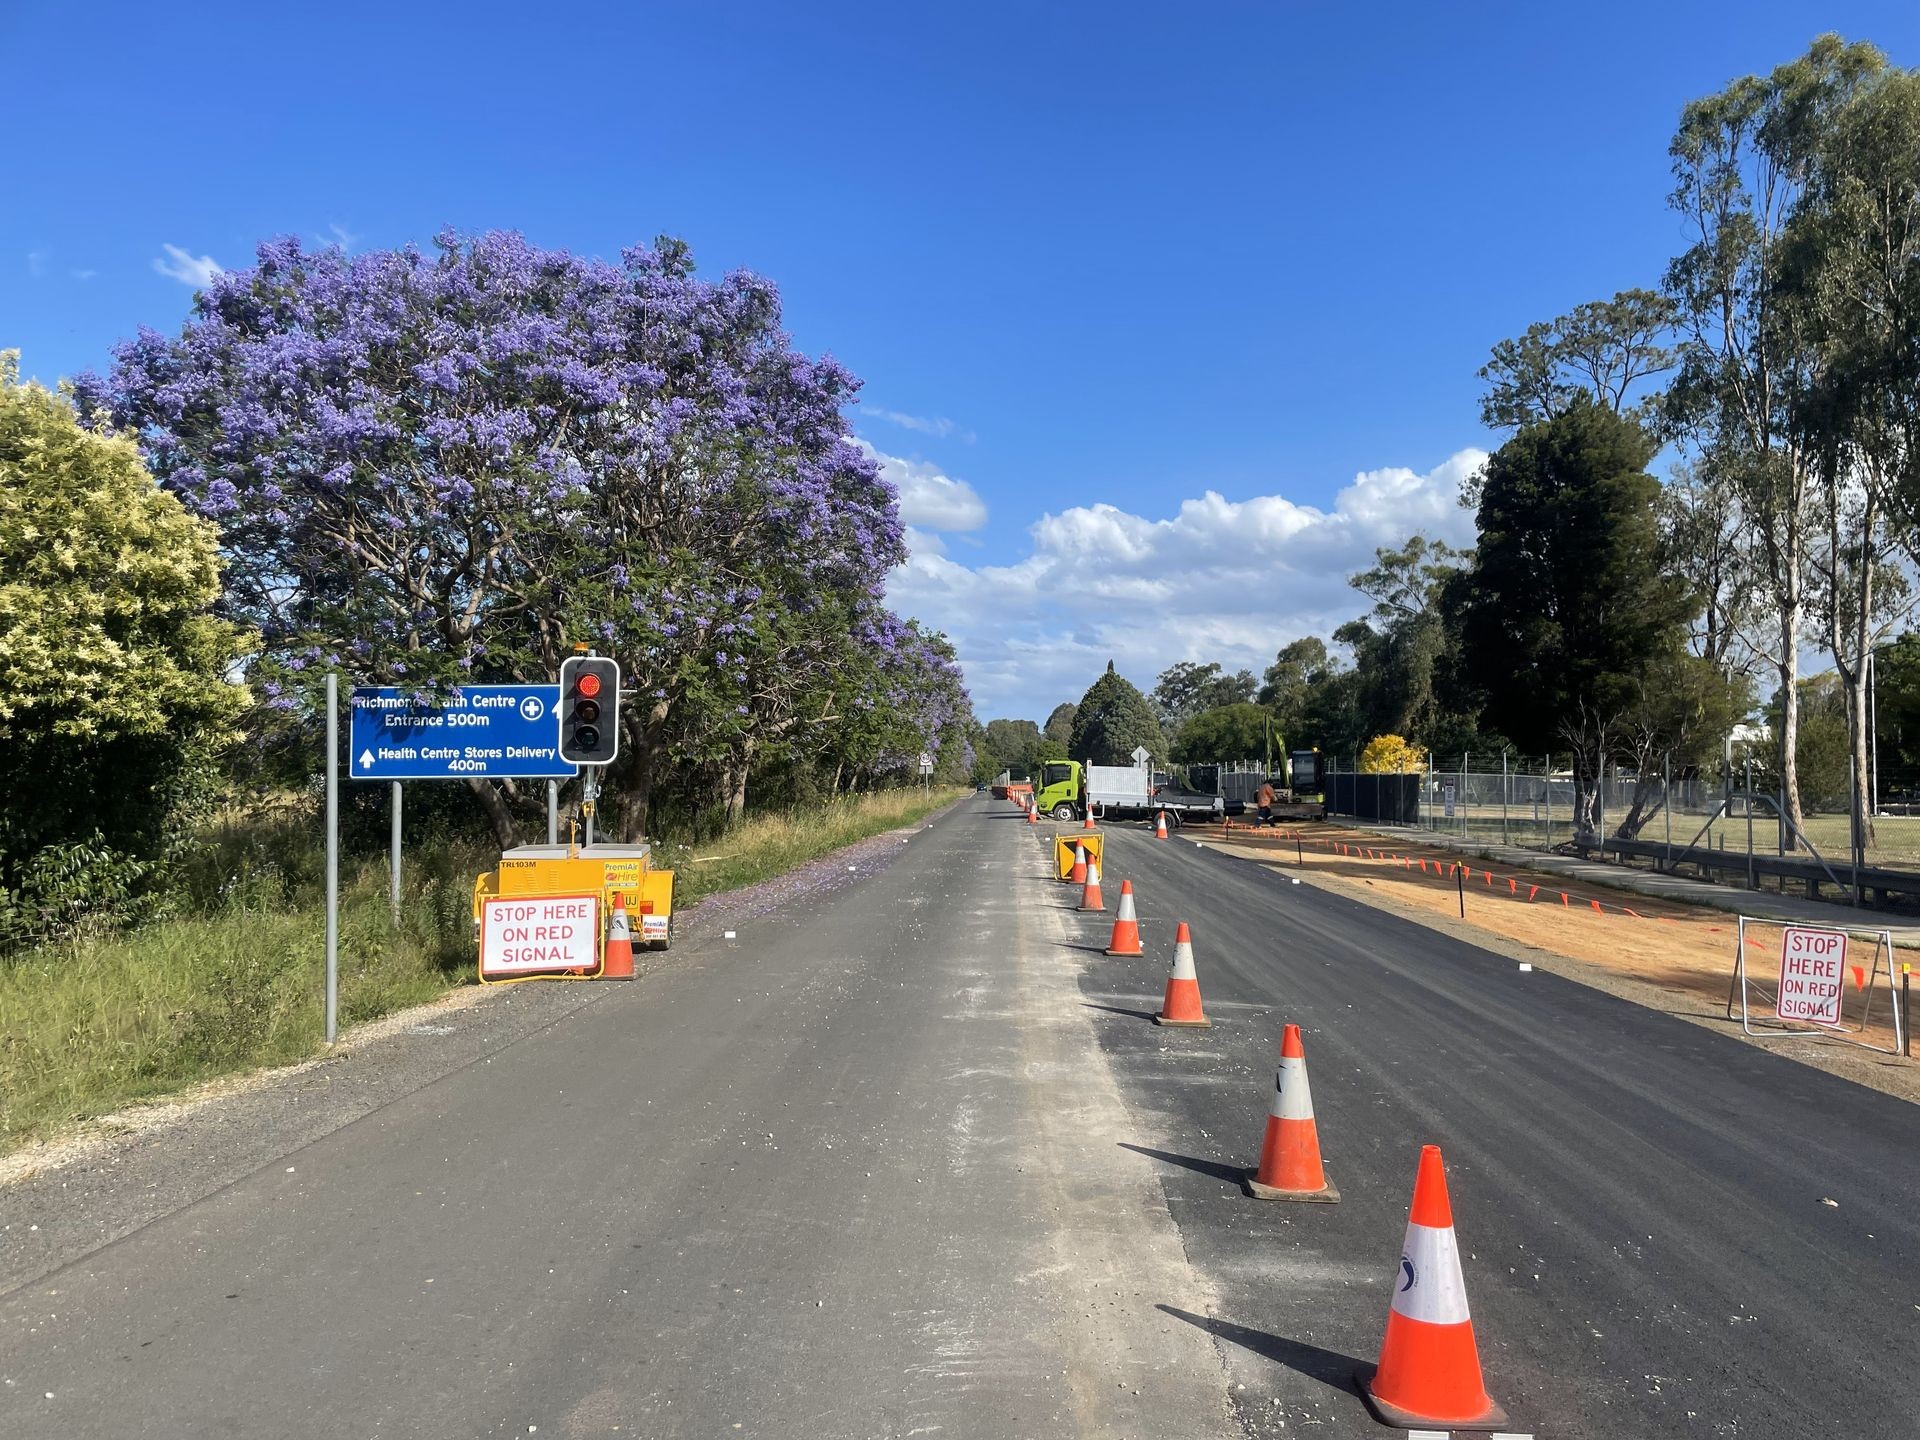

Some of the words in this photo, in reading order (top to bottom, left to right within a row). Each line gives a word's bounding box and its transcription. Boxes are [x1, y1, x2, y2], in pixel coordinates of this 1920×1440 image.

[472, 694, 516, 707] Centre
[385, 714, 443, 727] Entrance
[447, 713, 490, 727] 500m
[378, 748, 417, 759] Health
[421, 747, 460, 759] Centre
[464, 747, 502, 758] Stores
[506, 746, 556, 760] Delivery
[448, 760, 487, 771] 400m
[605, 863, 638, 871] PremiAir
[617, 872, 638, 881] Hire
[493, 906, 537, 922] STOP
[544, 904, 588, 920] HERE
[503, 927, 529, 942] ON
[535, 926, 573, 941] RED
[1791, 935, 1838, 955] STOP
[502, 946, 575, 963] SIGNAL
[1788, 957, 1836, 978] HERE
[1784, 979, 1804, 994] ON
[1808, 983, 1838, 998] RED
[1784, 999, 1833, 1018] SIGNAL
